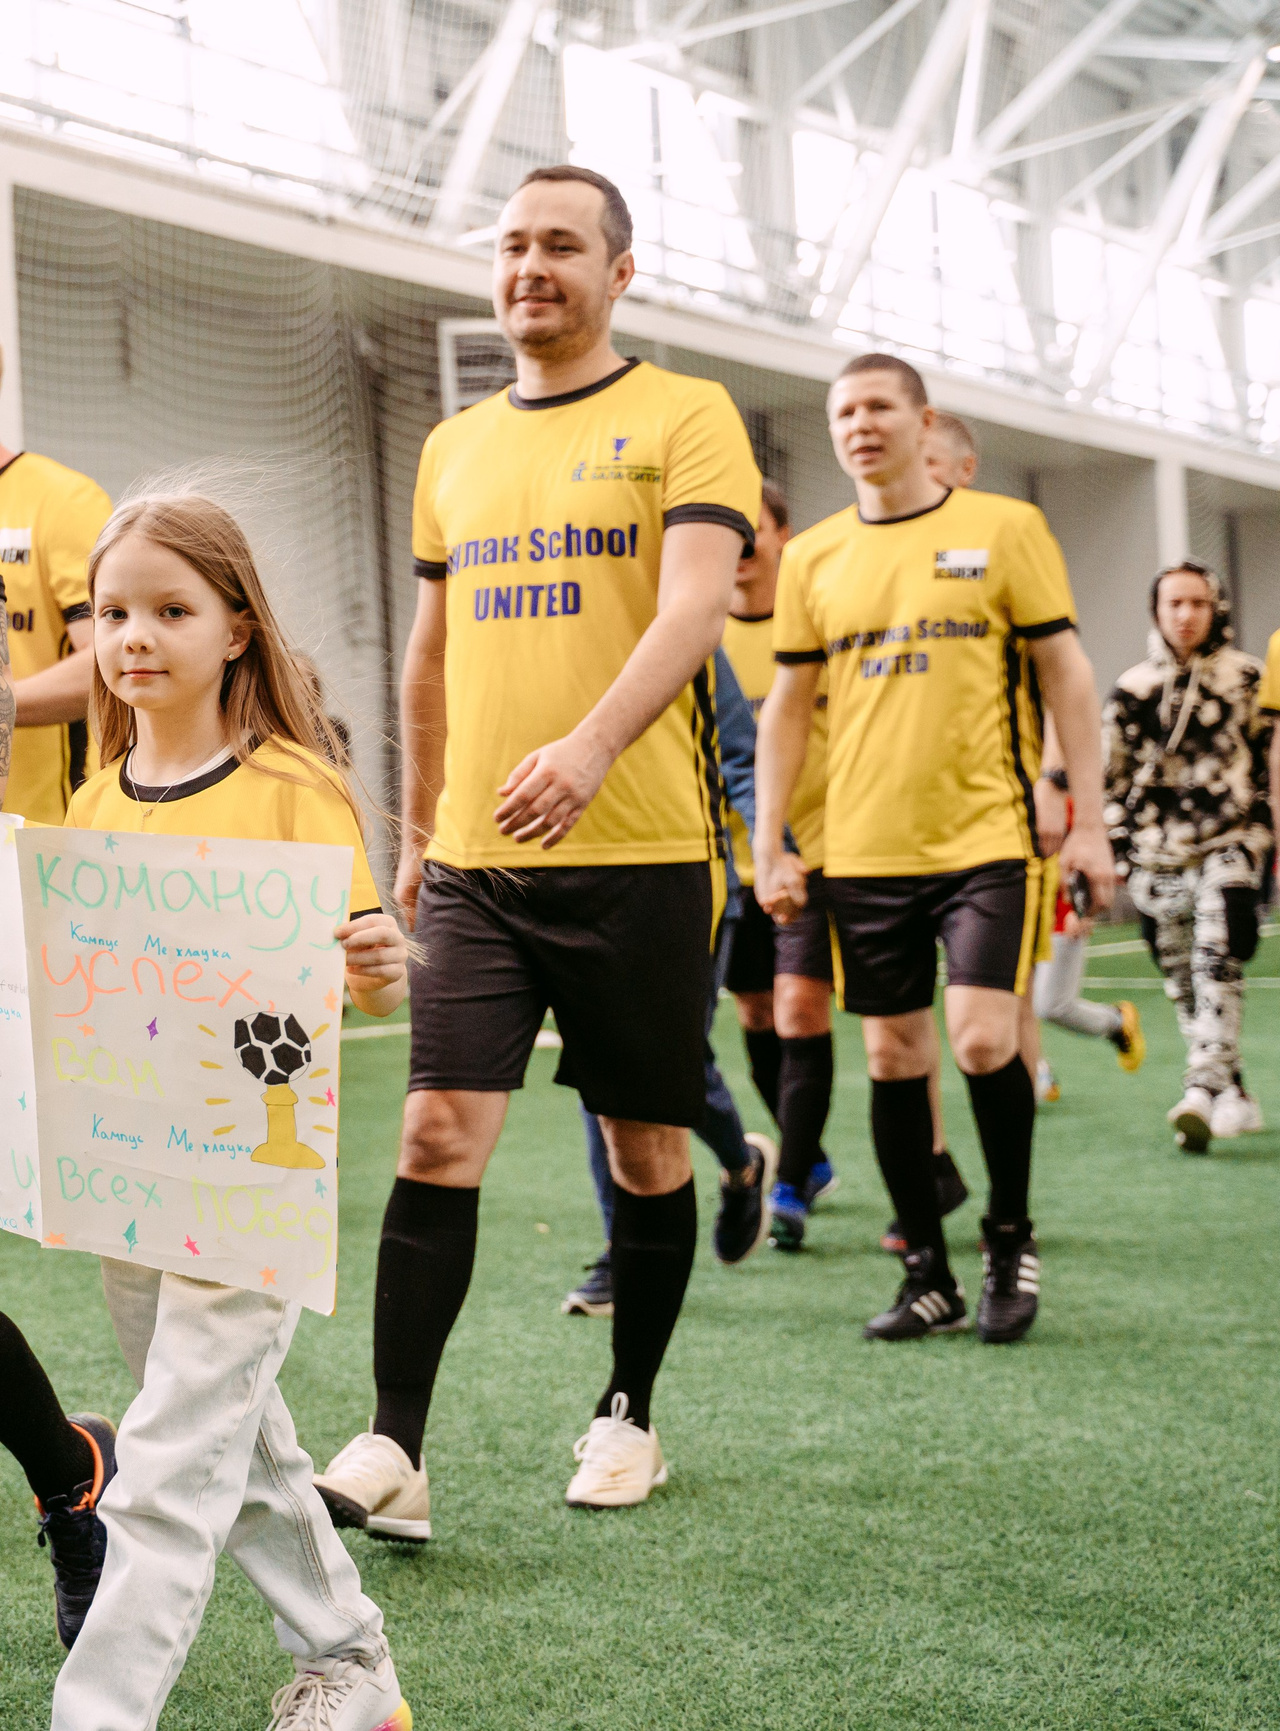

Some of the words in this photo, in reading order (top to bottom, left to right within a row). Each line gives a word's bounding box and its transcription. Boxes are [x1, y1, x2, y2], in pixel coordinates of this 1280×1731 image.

[447, 535, 520, 576] улак
[529, 523, 638, 563] School
[474, 582, 581, 621] UNITED
